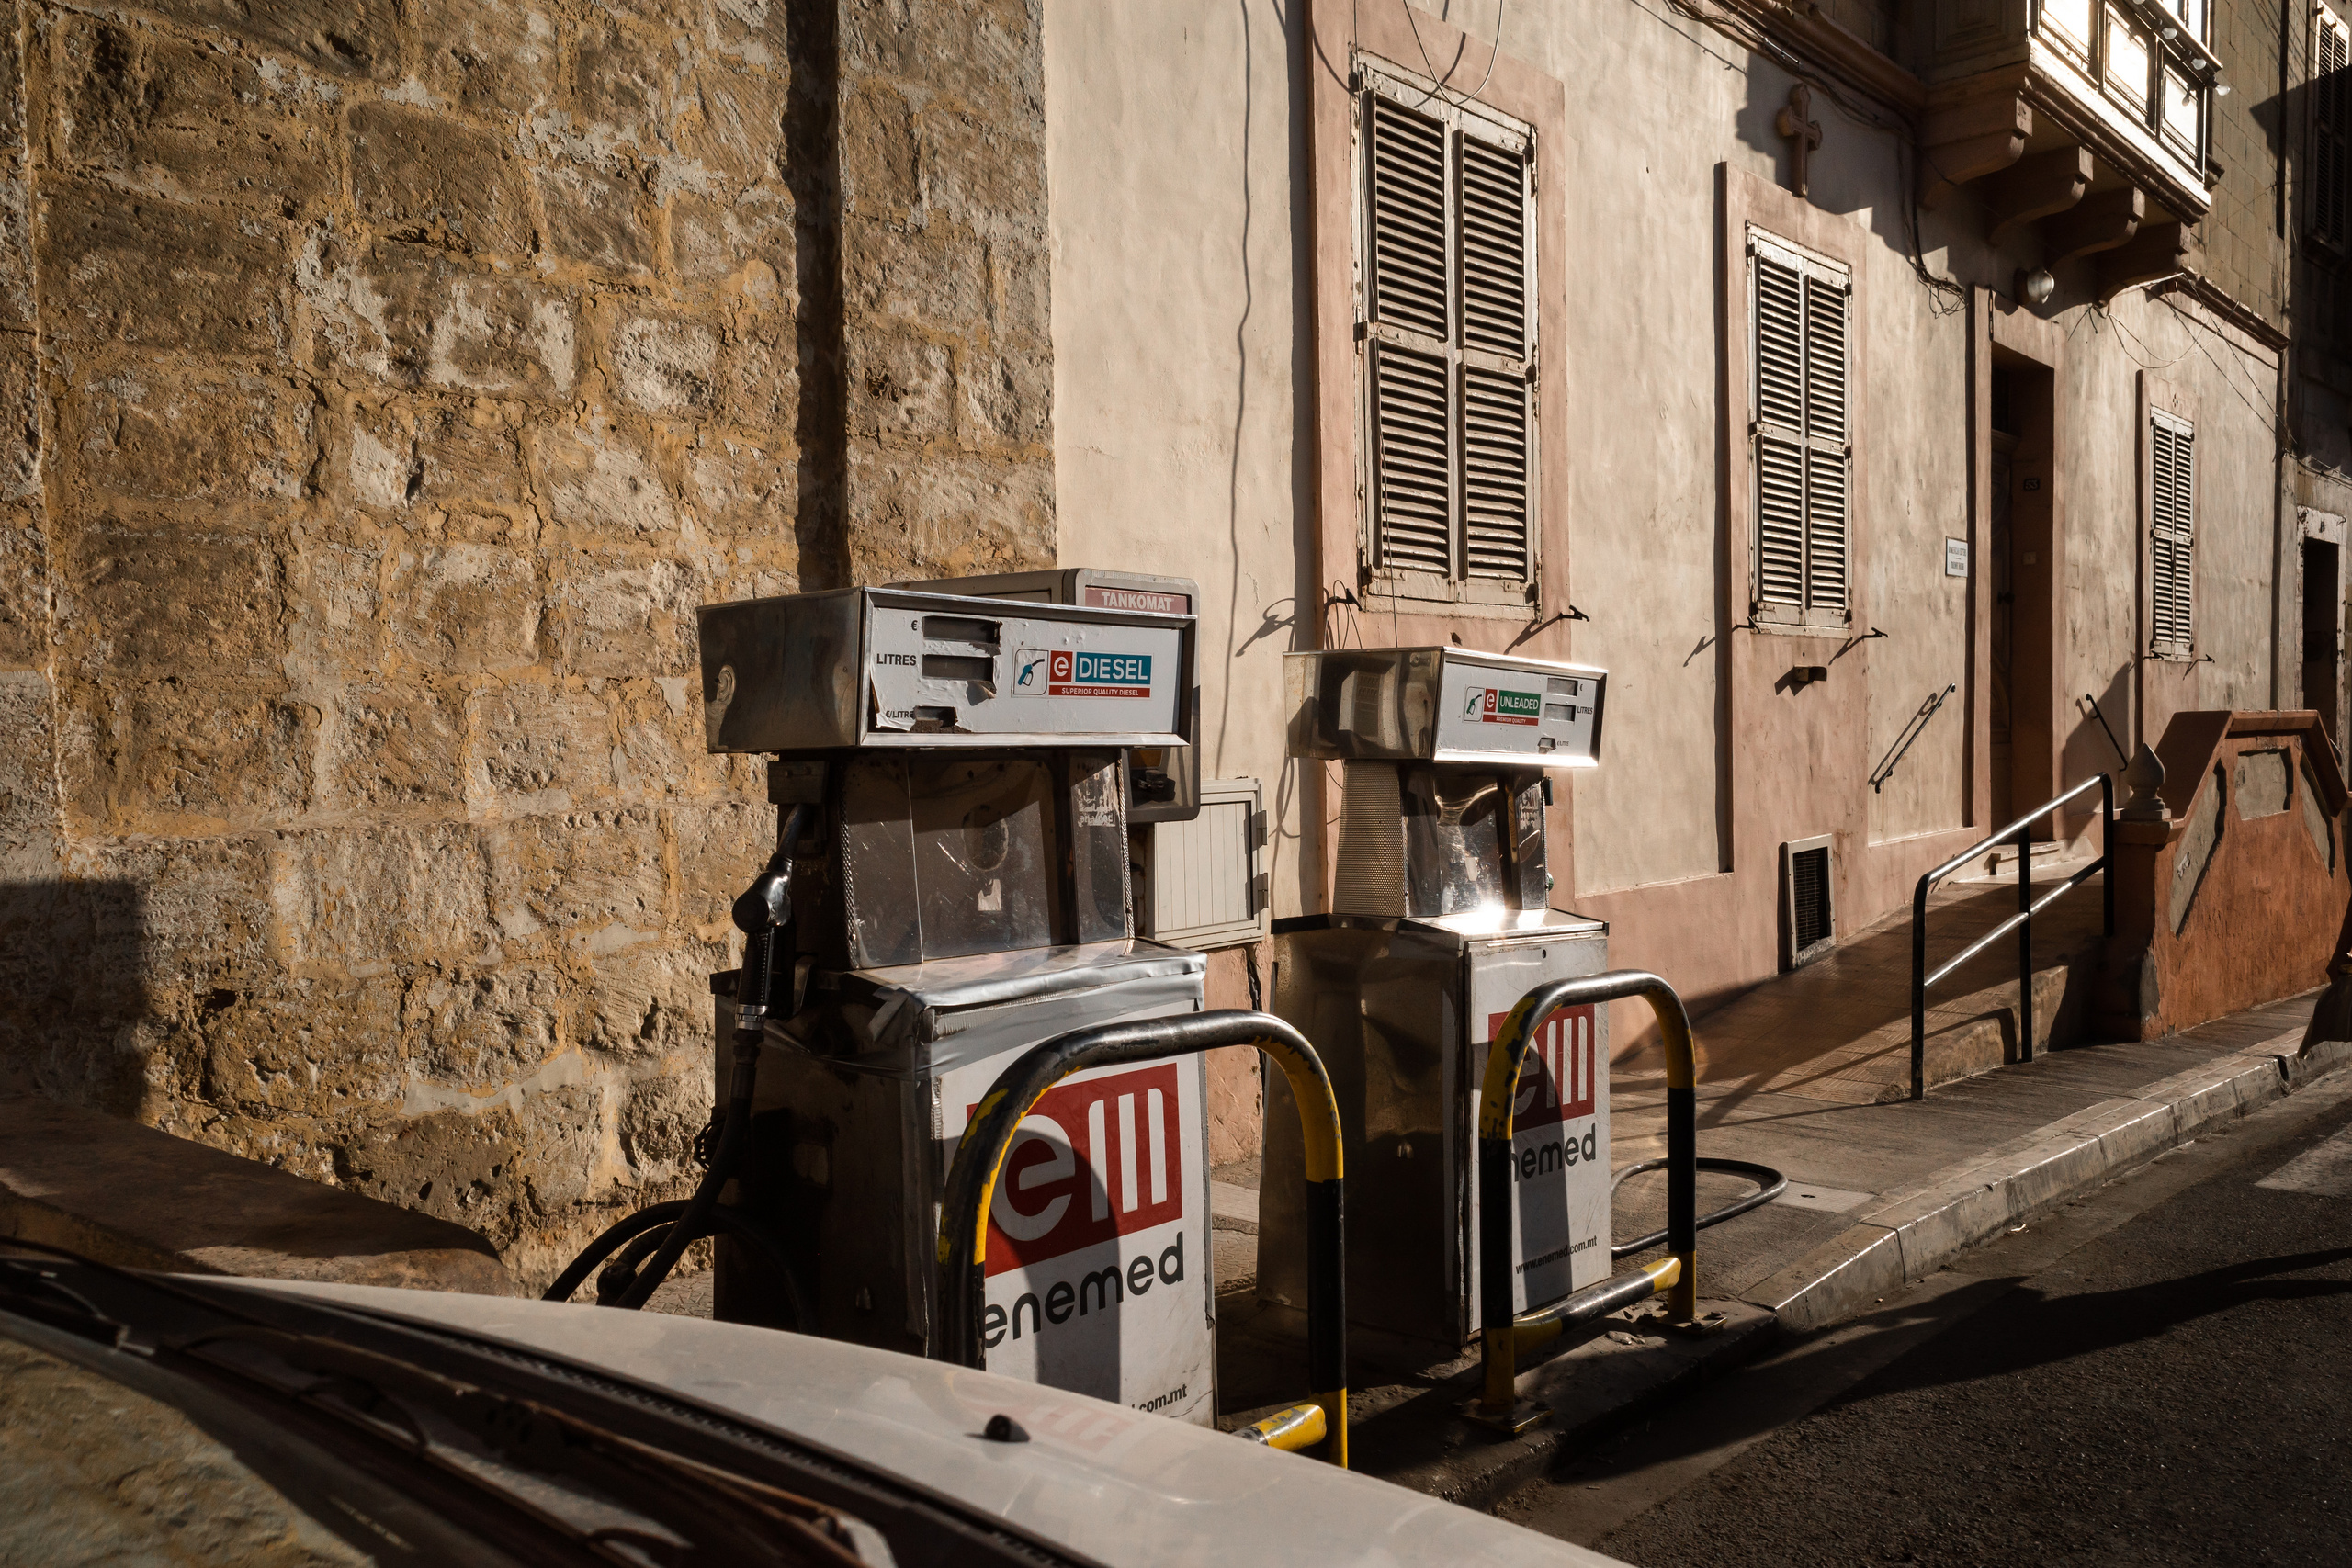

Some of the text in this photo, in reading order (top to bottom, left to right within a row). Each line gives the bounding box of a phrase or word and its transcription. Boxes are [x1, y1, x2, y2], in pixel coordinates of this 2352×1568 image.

[1101, 592, 1172, 611] TANKOMAT
[910, 620, 918, 631] €
[876, 653, 917, 666] LITRES
[1079, 657, 1148, 680] DIESEL
[1061, 687, 1092, 695] SUPERIOR
[1499, 695, 1539, 710] UNLEADED
[1577, 705, 1593, 715] LITRES
[1511, 1122, 1597, 1182] nemed
[1516, 1235, 1598, 1274] www.enemed.com.mt
[985, 1231, 1185, 1348] enemed
